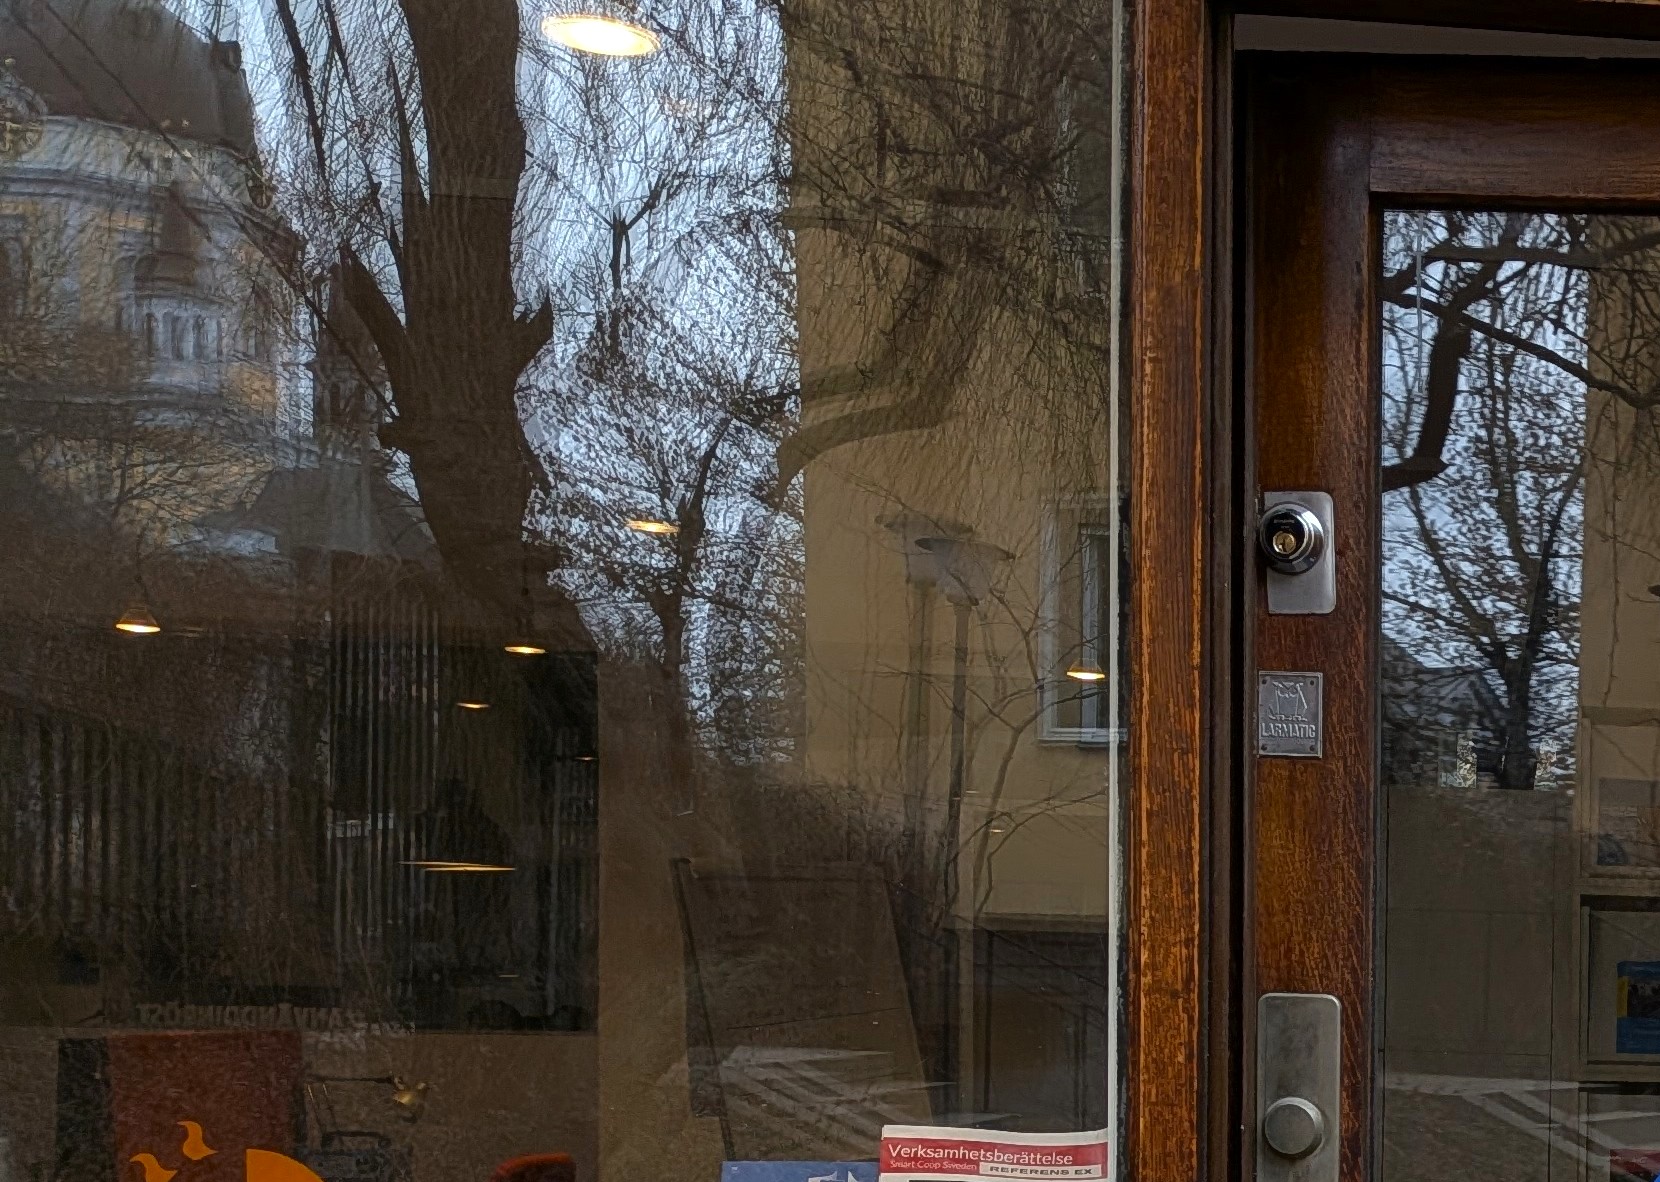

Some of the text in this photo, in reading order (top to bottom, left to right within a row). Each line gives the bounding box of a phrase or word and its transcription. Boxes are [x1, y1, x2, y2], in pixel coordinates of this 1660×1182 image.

[1260, 722, 1316, 738] LARMATIC
[887, 1143, 1074, 1166] Verksamhetsberättelse
[988, 1165, 1094, 1177] REFERENS EX
